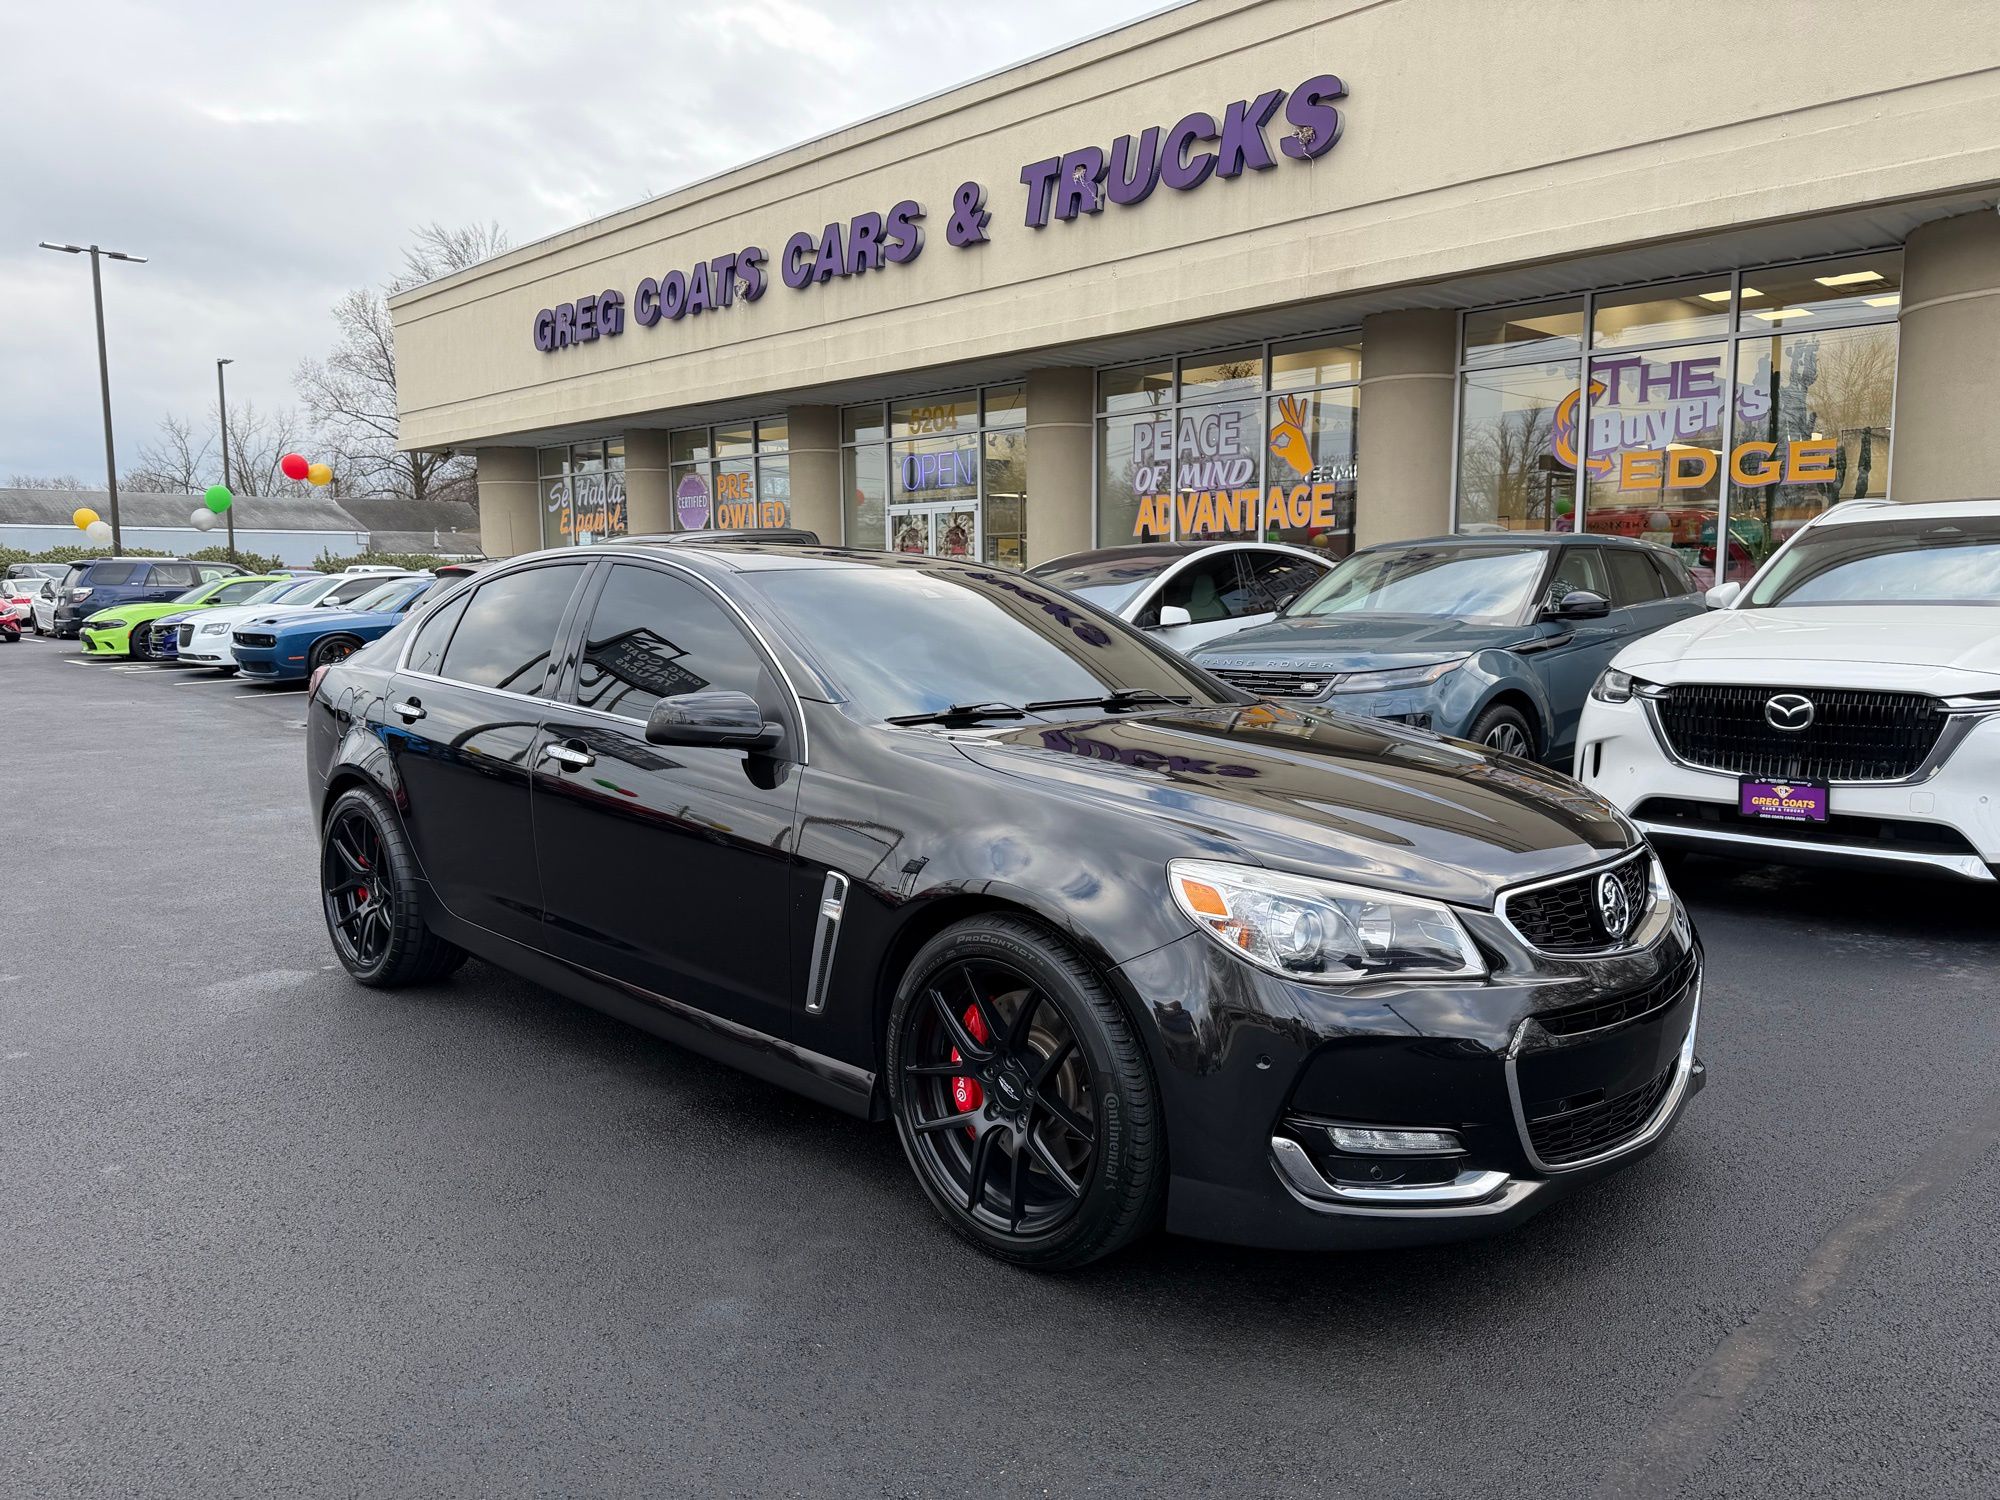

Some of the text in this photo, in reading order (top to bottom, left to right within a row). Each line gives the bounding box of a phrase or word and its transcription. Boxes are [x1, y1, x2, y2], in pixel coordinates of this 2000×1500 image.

[533, 74, 1350, 353] GREG COATS CARS & TRUCKS
[1592, 355, 1721, 406] THE
[909, 403, 958, 435] 5204
[1133, 411, 1241, 463] PEACE
[902, 449, 974, 491] OPEN
[1133, 459, 1254, 495] OF MIND
[1617, 437, 1838, 493] EDGE
[548, 482, 570, 513] Se
[677, 495, 708, 509] CERTIFIED
[717, 501, 785, 529] OWNED
[1132, 483, 1336, 537] ADVANTAGE
[1201, 658, 1335, 669] RANGE ROVER
[1751, 796, 1816, 809] GREG COATS
[1104, 1092, 1121, 1180] Continental
